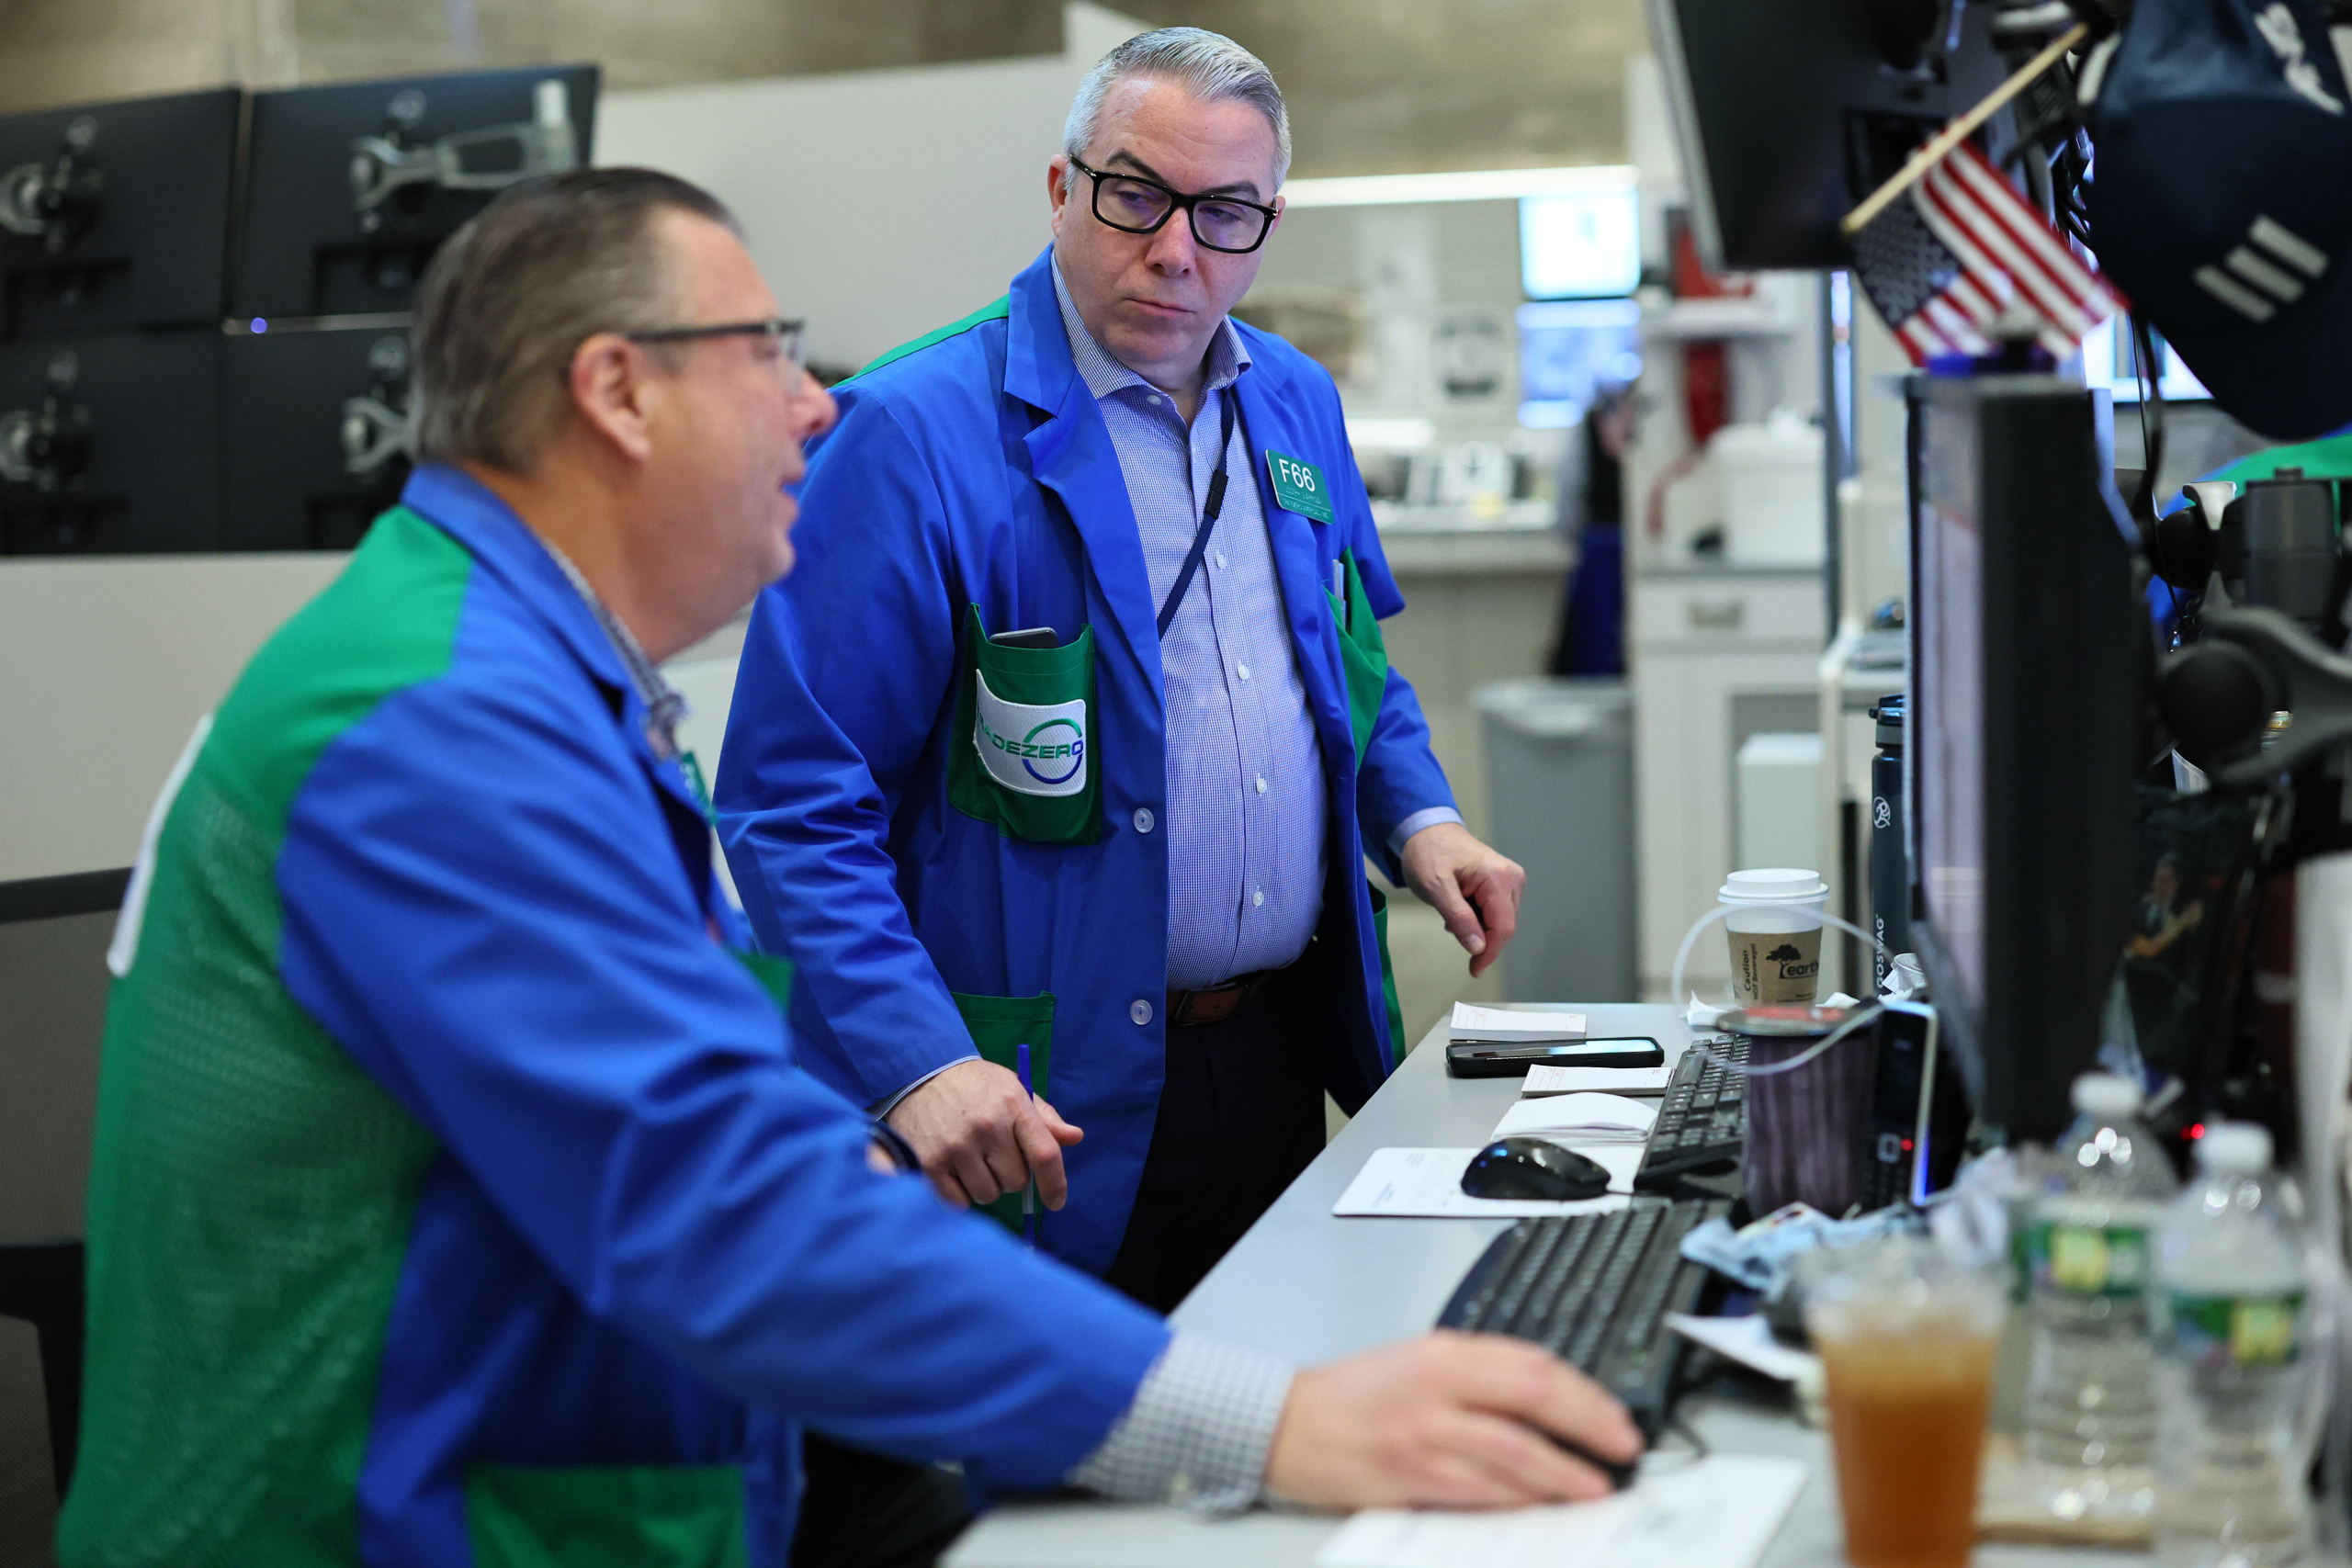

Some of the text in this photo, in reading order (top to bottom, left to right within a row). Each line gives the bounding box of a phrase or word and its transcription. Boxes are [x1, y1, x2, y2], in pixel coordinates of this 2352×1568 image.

[1278, 457, 1316, 492] F66
[978, 705, 1084, 760] RADEZERO
[1742, 949, 1752, 992] Caution
[1876, 918, 1884, 989] GOSWAG
